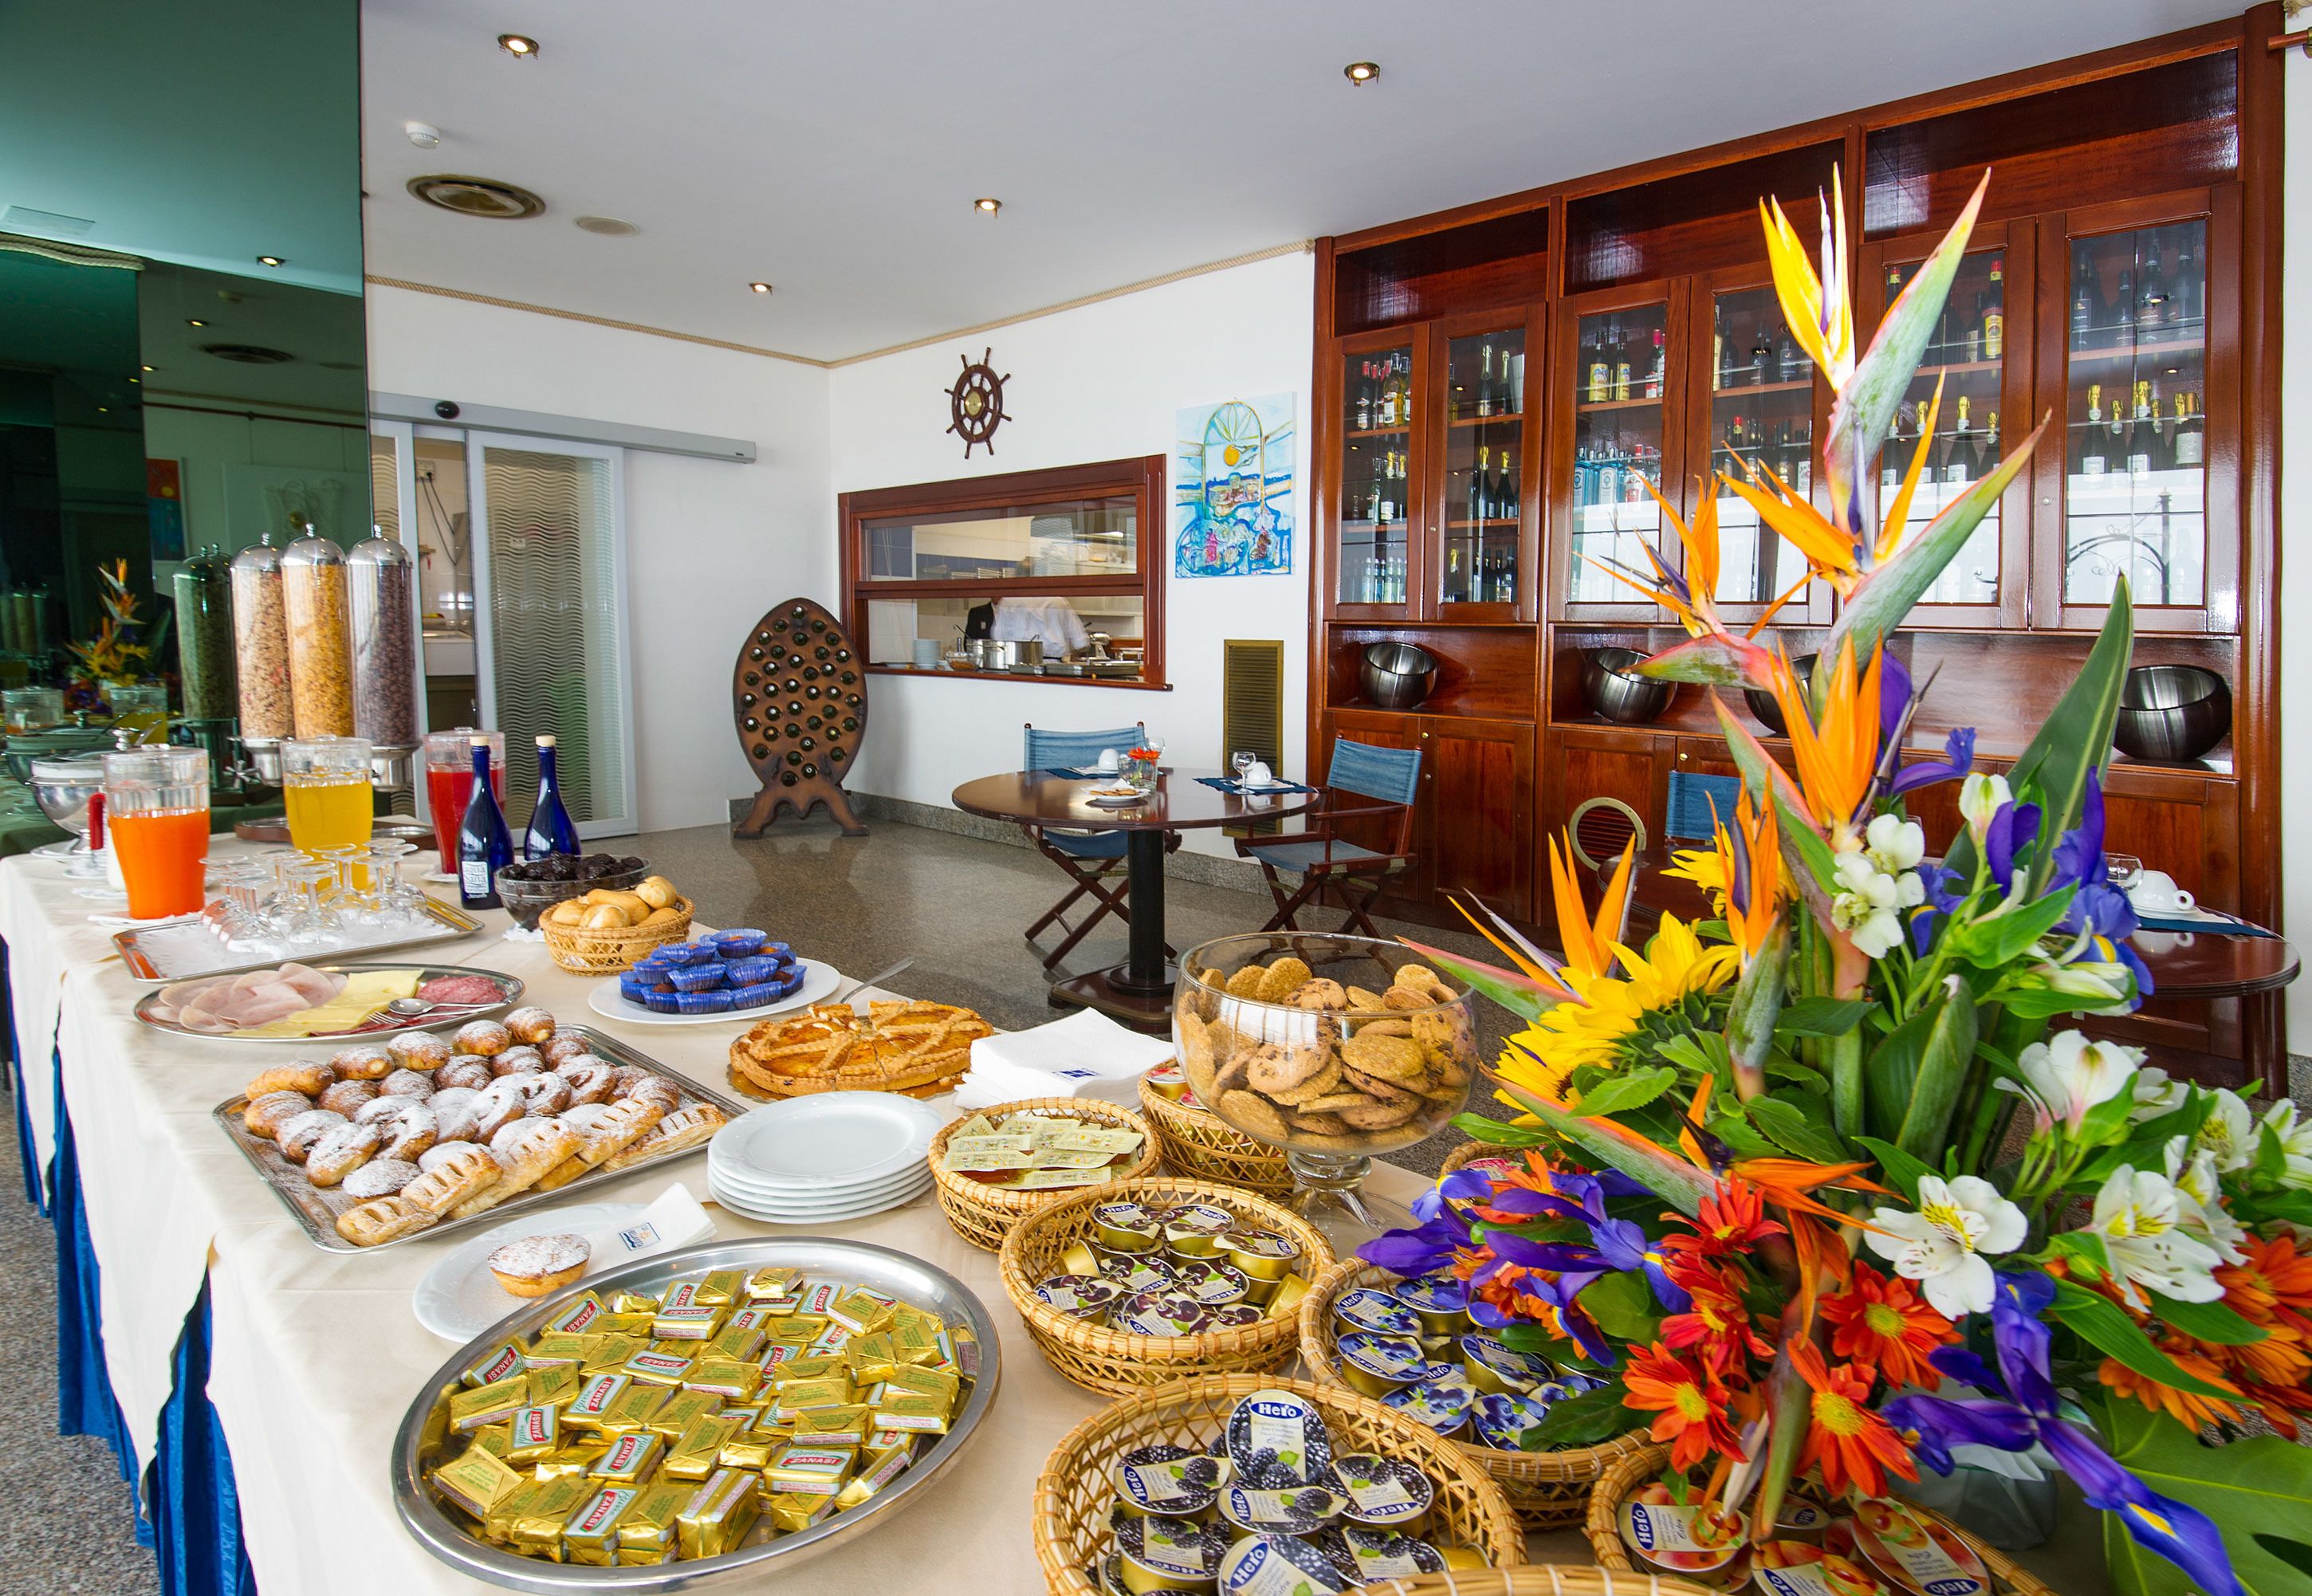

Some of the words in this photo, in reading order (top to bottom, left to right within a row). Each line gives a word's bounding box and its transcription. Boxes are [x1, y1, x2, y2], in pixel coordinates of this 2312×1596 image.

[816, 1288, 829, 1309] ZANASI
[1341, 1294, 1362, 1307] Hero
[488, 1354, 513, 1380] ZANASI
[643, 1358, 682, 1367] ZANASI
[591, 1380, 612, 1408] ZANASI
[1258, 1403, 1297, 1417] Hero
[531, 1413, 542, 1439] ZANASI
[613, 1440, 634, 1468] ZANASI
[1126, 1471, 1146, 1497] Hero
[585, 1496, 613, 1527] ZANASI
[1233, 1493, 1249, 1518] Hero
[1370, 1504, 1411, 1516] Hero
[1633, 1509, 1653, 1543] Hero
[1153, 1560, 1196, 1574] Hero
[1233, 1548, 1265, 1585] Hero
[1929, 1580, 1974, 1596] Hero
